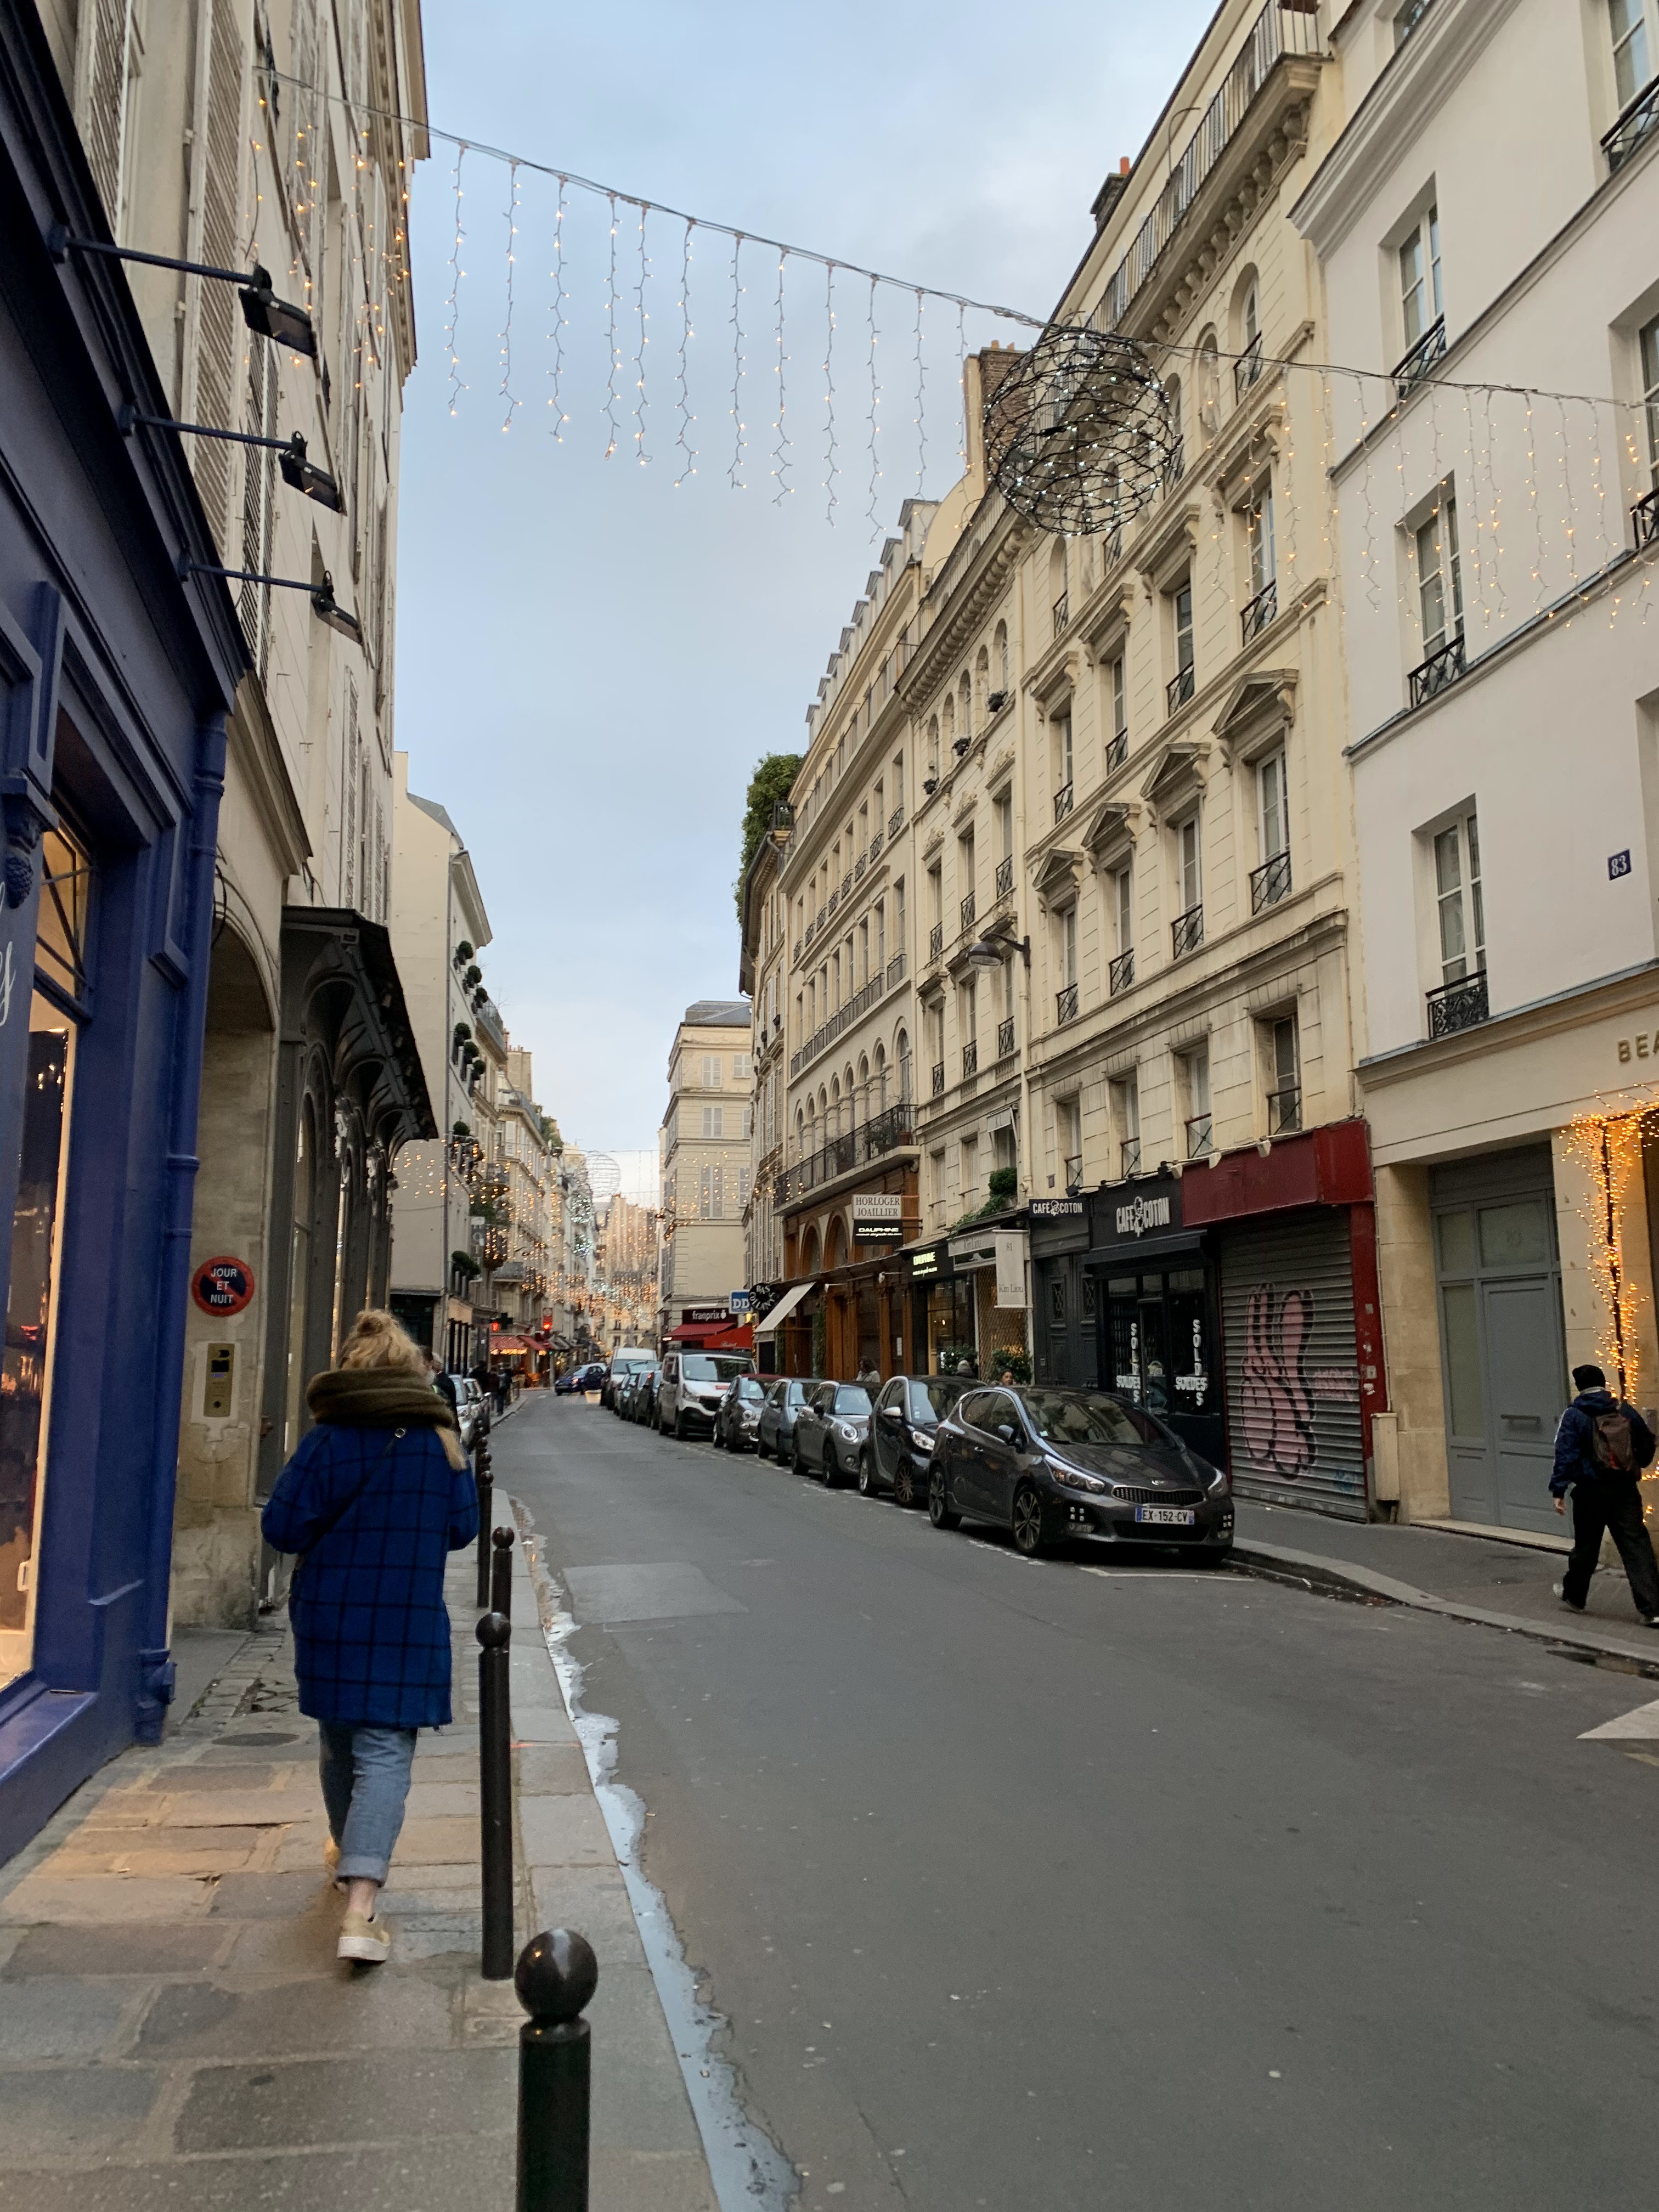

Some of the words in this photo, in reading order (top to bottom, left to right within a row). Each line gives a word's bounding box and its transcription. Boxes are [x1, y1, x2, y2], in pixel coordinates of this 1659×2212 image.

[1611, 855, 1627, 876] 83
[856, 1197, 900, 1206] HORLOGER
[857, 1207, 899, 1217] JOAILLIER
[1032, 1201, 1050, 1214] CAFÉ
[1059, 1202, 1083, 1214] COTON
[1143, 1197, 1170, 1229] COTON
[211, 1268, 237, 1278] JOUR
[216, 1280, 229, 1290] ET
[210, 1294, 234, 1304] NUIT
[732, 1298, 751, 1309] DD
[692, 1310, 720, 1321] franprix
[1175, 1376, 1208, 1391] SOLDES
